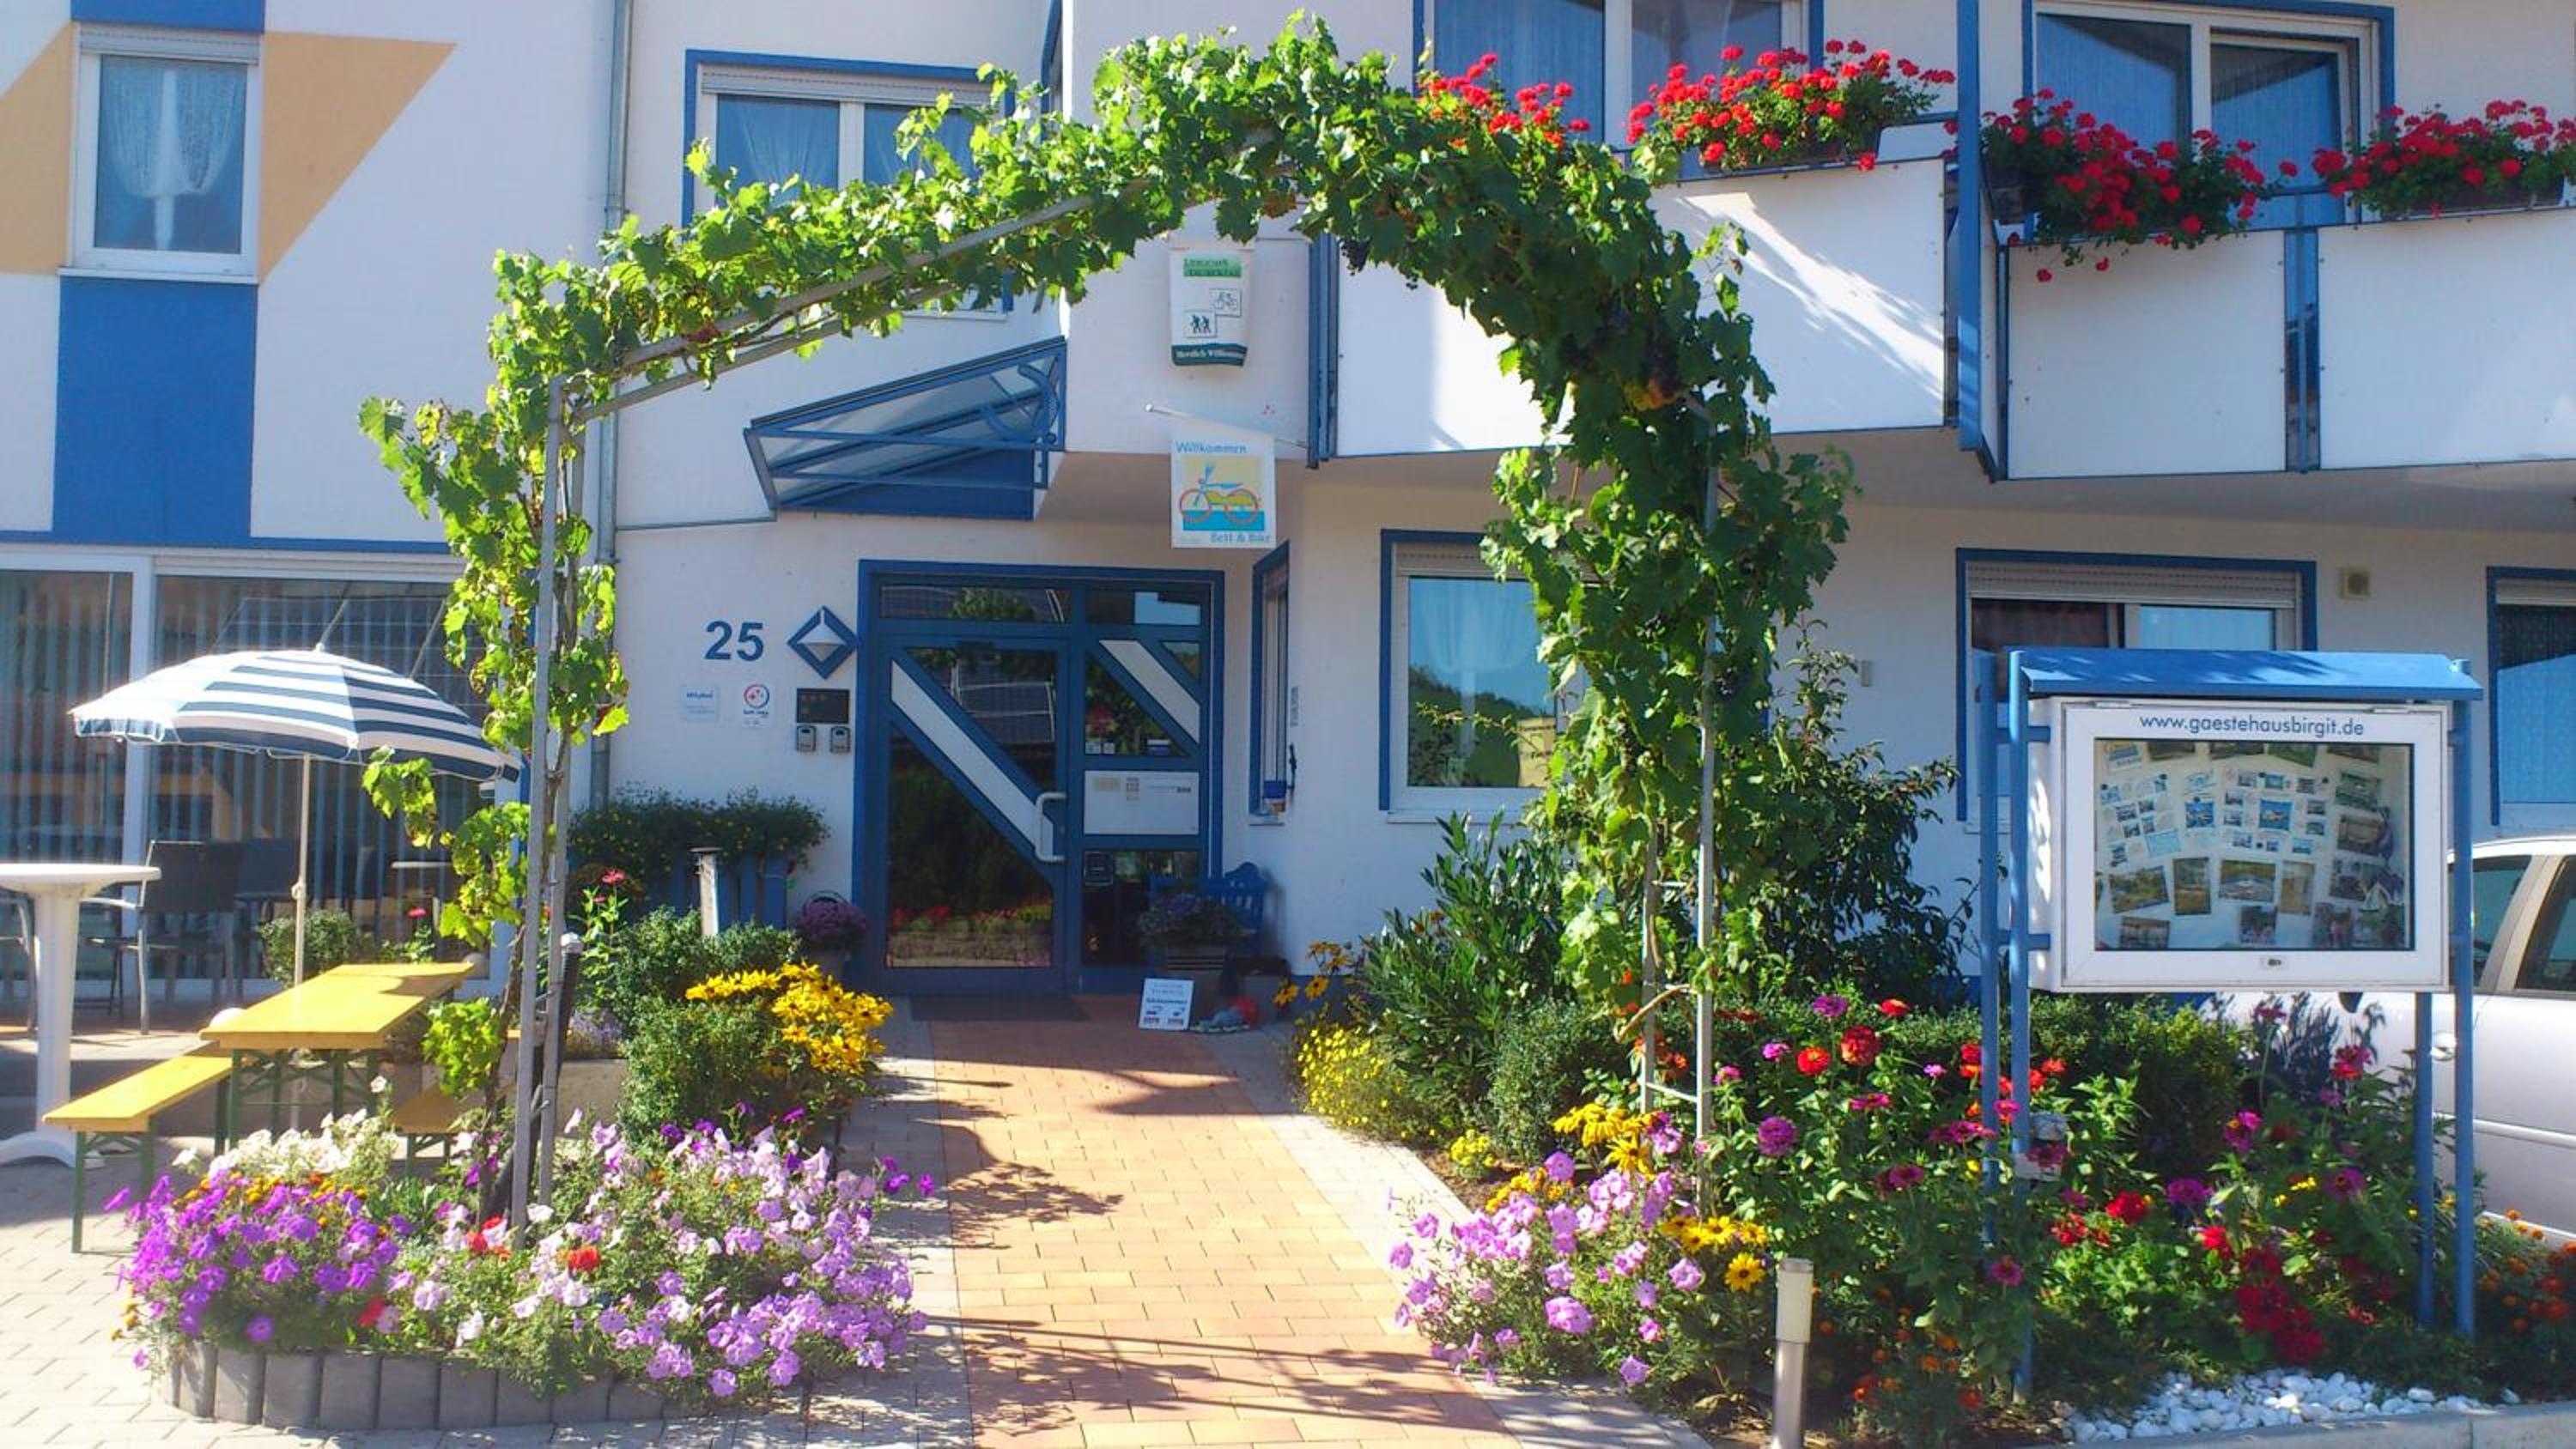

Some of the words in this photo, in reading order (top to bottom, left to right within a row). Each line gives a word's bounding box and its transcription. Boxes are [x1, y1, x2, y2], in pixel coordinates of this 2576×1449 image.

[1174, 440, 1246, 453] Willkommen
[705, 621, 763, 661] 25
[2139, 714, 2364, 738] www.gaestehausbirgit.de
